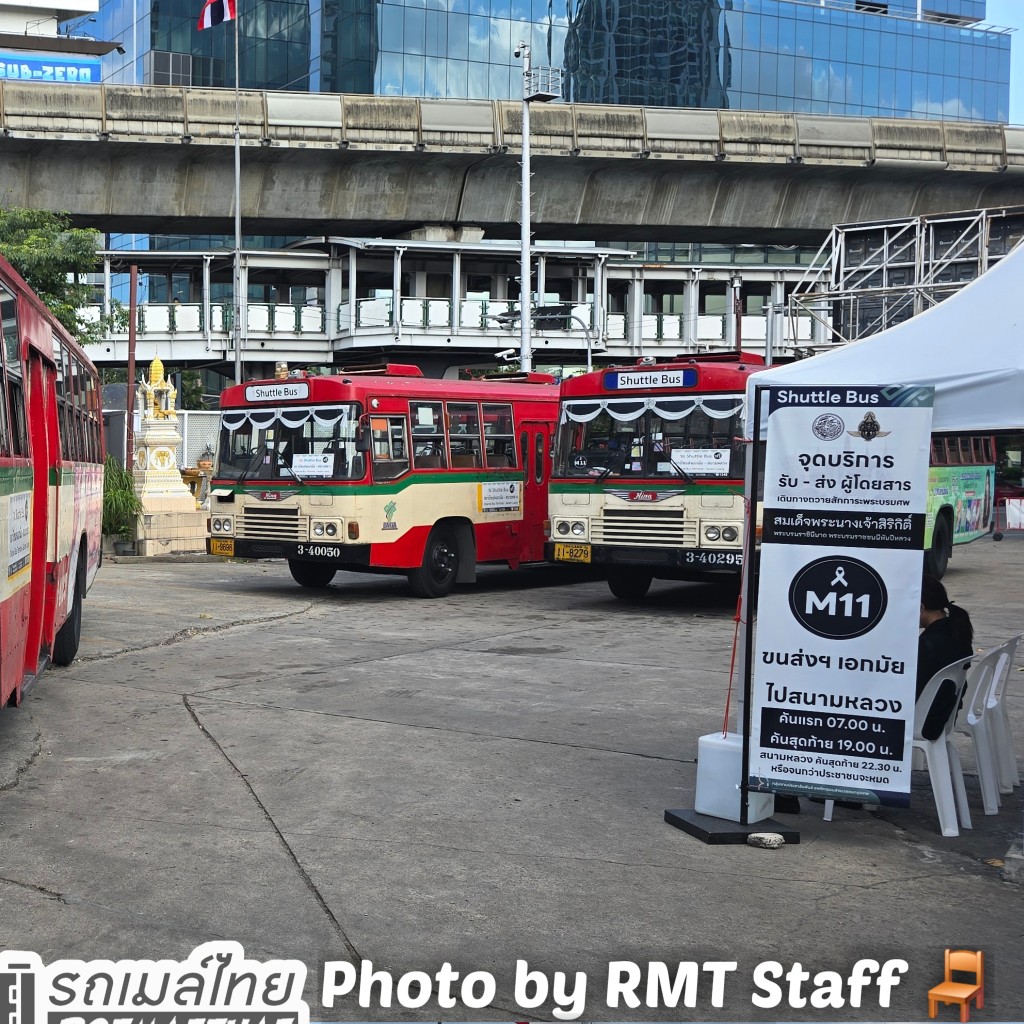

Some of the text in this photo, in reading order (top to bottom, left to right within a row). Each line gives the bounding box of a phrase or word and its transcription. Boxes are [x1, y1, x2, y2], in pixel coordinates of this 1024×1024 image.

[619, 374, 681, 386] Shuttle Bus
[255, 387, 298, 398] Shuttle Bus
[777, 390, 880, 404] Shuttle Bus
[798, 450, 895, 472] จุดบริการ
[778, 473, 798, 488] รับ
[815, 474, 837, 489] ส่ง
[841, 474, 912, 494] ผู้โดยสาร
[633, 492, 653, 500] Hino
[297, 544, 341, 558] 3-40050
[557, 547, 589, 558] 11-8279
[685, 552, 744, 565] 3-40295
[804, 590, 871, 618] M11
[762, 648, 906, 676] ขนส่งฯ เอกมัย
[765, 682, 904, 714] ไปสนามหลวง
[779, 711, 886, 733] คันแรก 07.00 น.
[770, 731, 894, 756] คันสุดท้าย 19.00 น.
[759, 751, 903, 773] สนามหลวง คันสุดท้าย 22.30 น.
[771, 763, 890, 785] หรือจนกว่าประชาชนจะหมด
